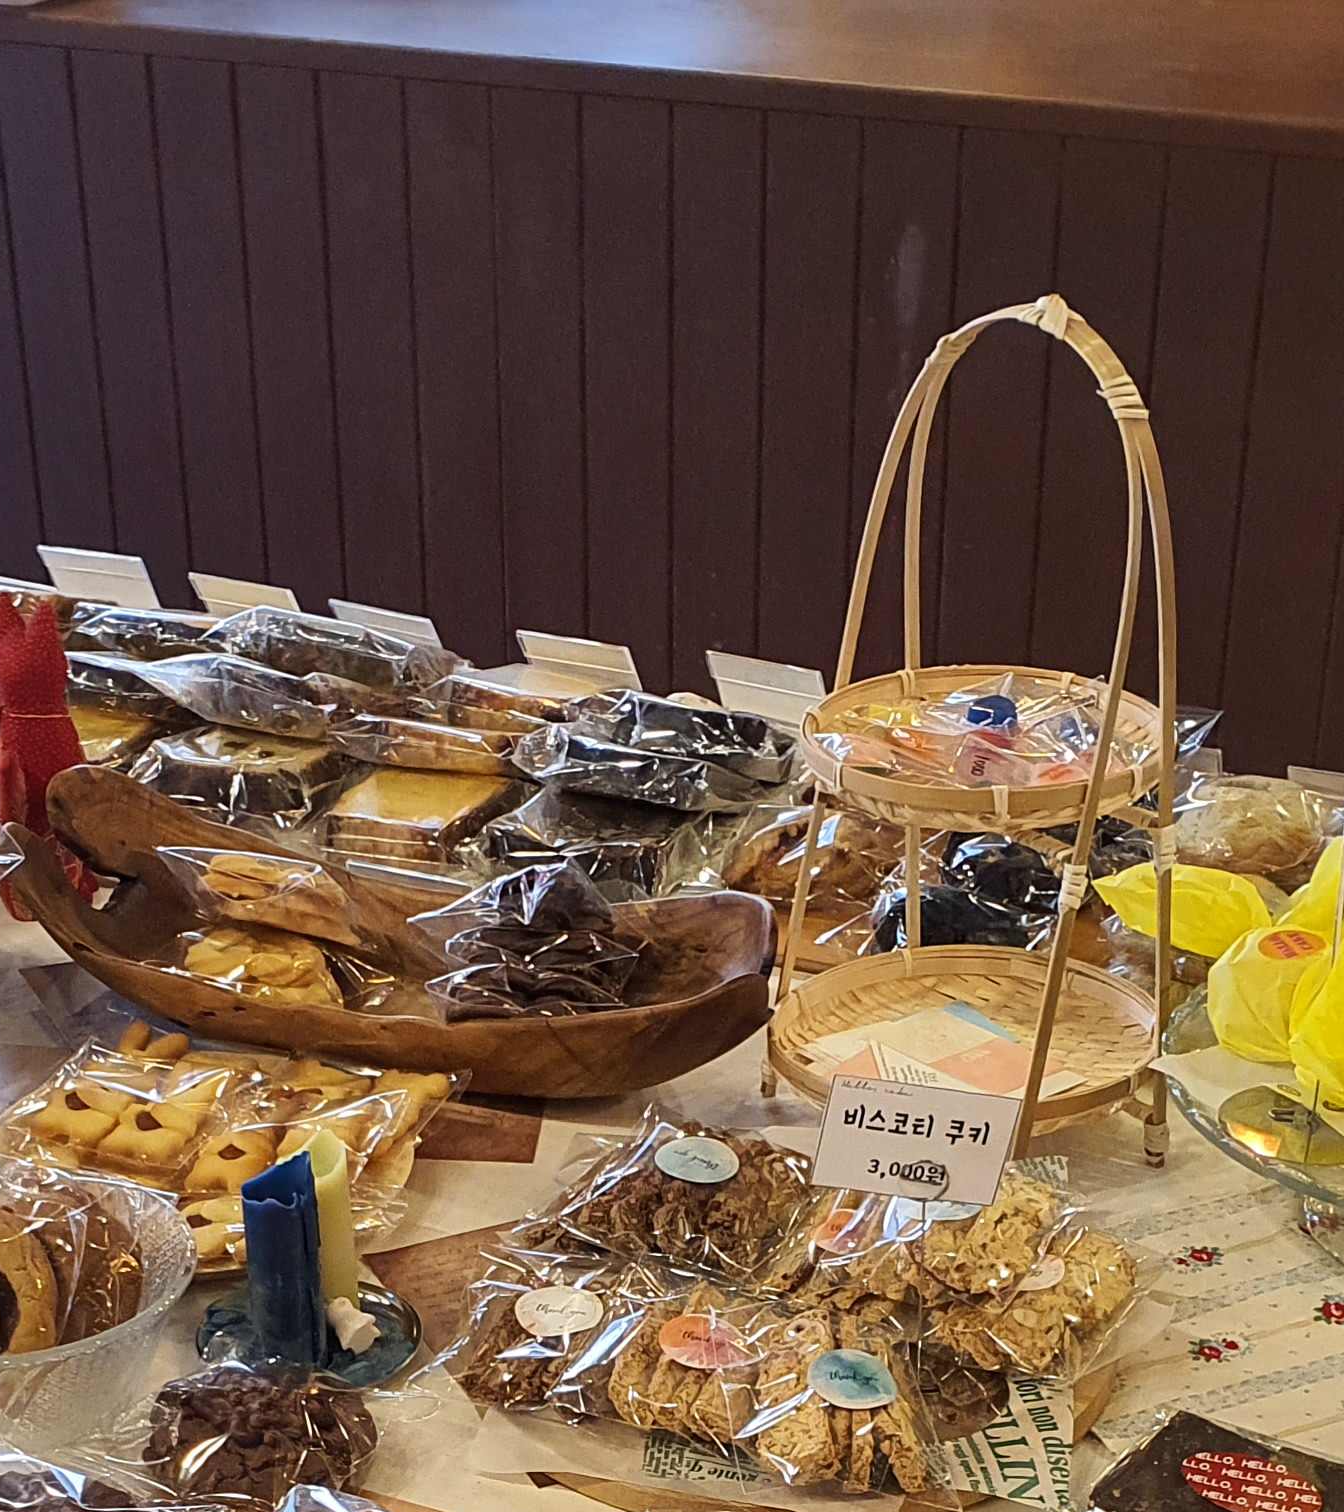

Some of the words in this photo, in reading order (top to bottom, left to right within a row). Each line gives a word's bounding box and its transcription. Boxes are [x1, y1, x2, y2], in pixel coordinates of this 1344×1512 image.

[843, 1104, 934, 1138] 비스코티
[945, 1119, 991, 1146] 쿠키
[867, 1159, 946, 1186] 3,000원
[1221, 1467, 1269, 1485] HELLO,
[1276, 1477, 1317, 1492] HELL
[1241, 1458, 1288, 1475] HELLO,
[1185, 1472, 1233, 1491] HELLO,
[1240, 1484, 1288, 1502] HELLO,
[1201, 1489, 1249, 1507] HELLO,
